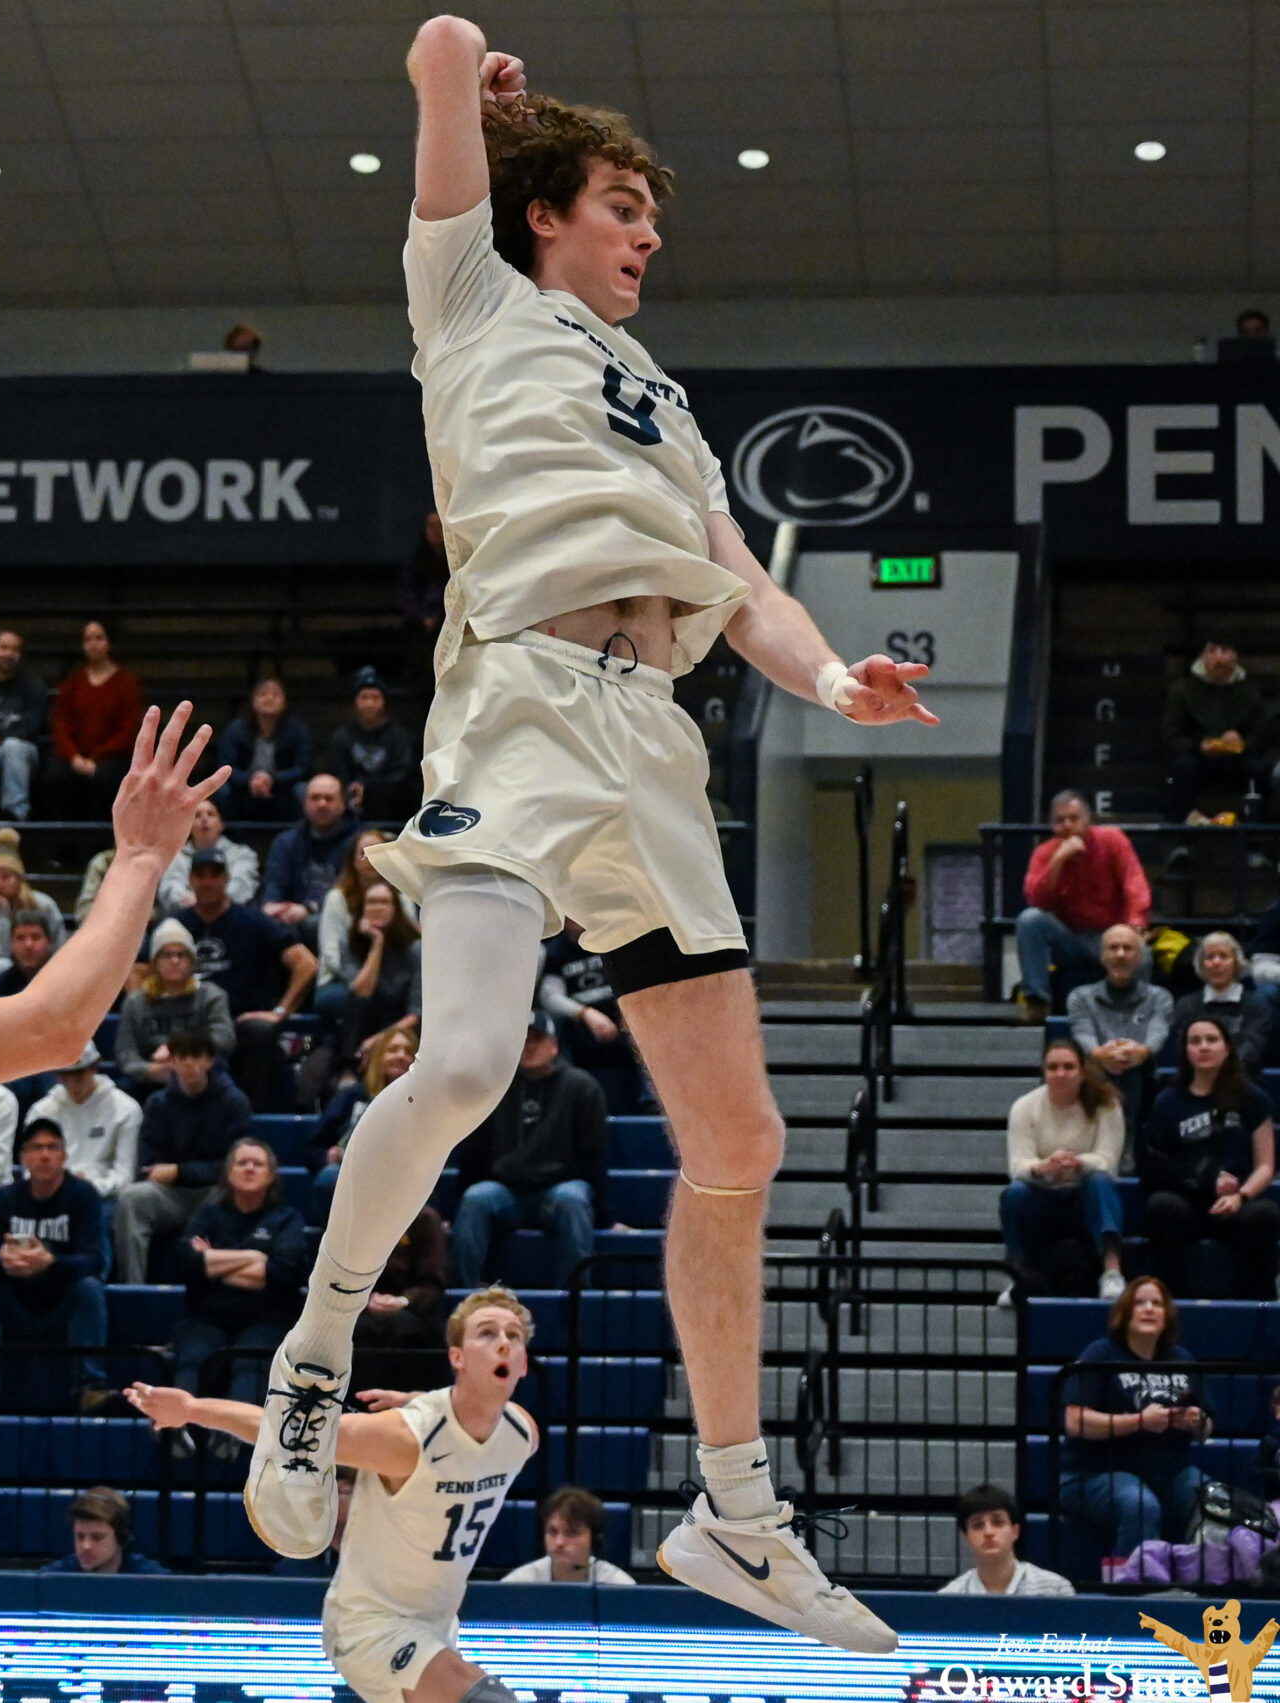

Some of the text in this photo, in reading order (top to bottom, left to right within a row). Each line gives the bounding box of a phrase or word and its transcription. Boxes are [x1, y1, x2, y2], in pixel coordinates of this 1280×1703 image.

[880, 557, 934, 582] EXIT
[886, 630, 935, 669] S3
[1095, 790, 1113, 818] E
[435, 1473, 508, 1493] PENN STATE
[432, 1497, 496, 1561] 15
